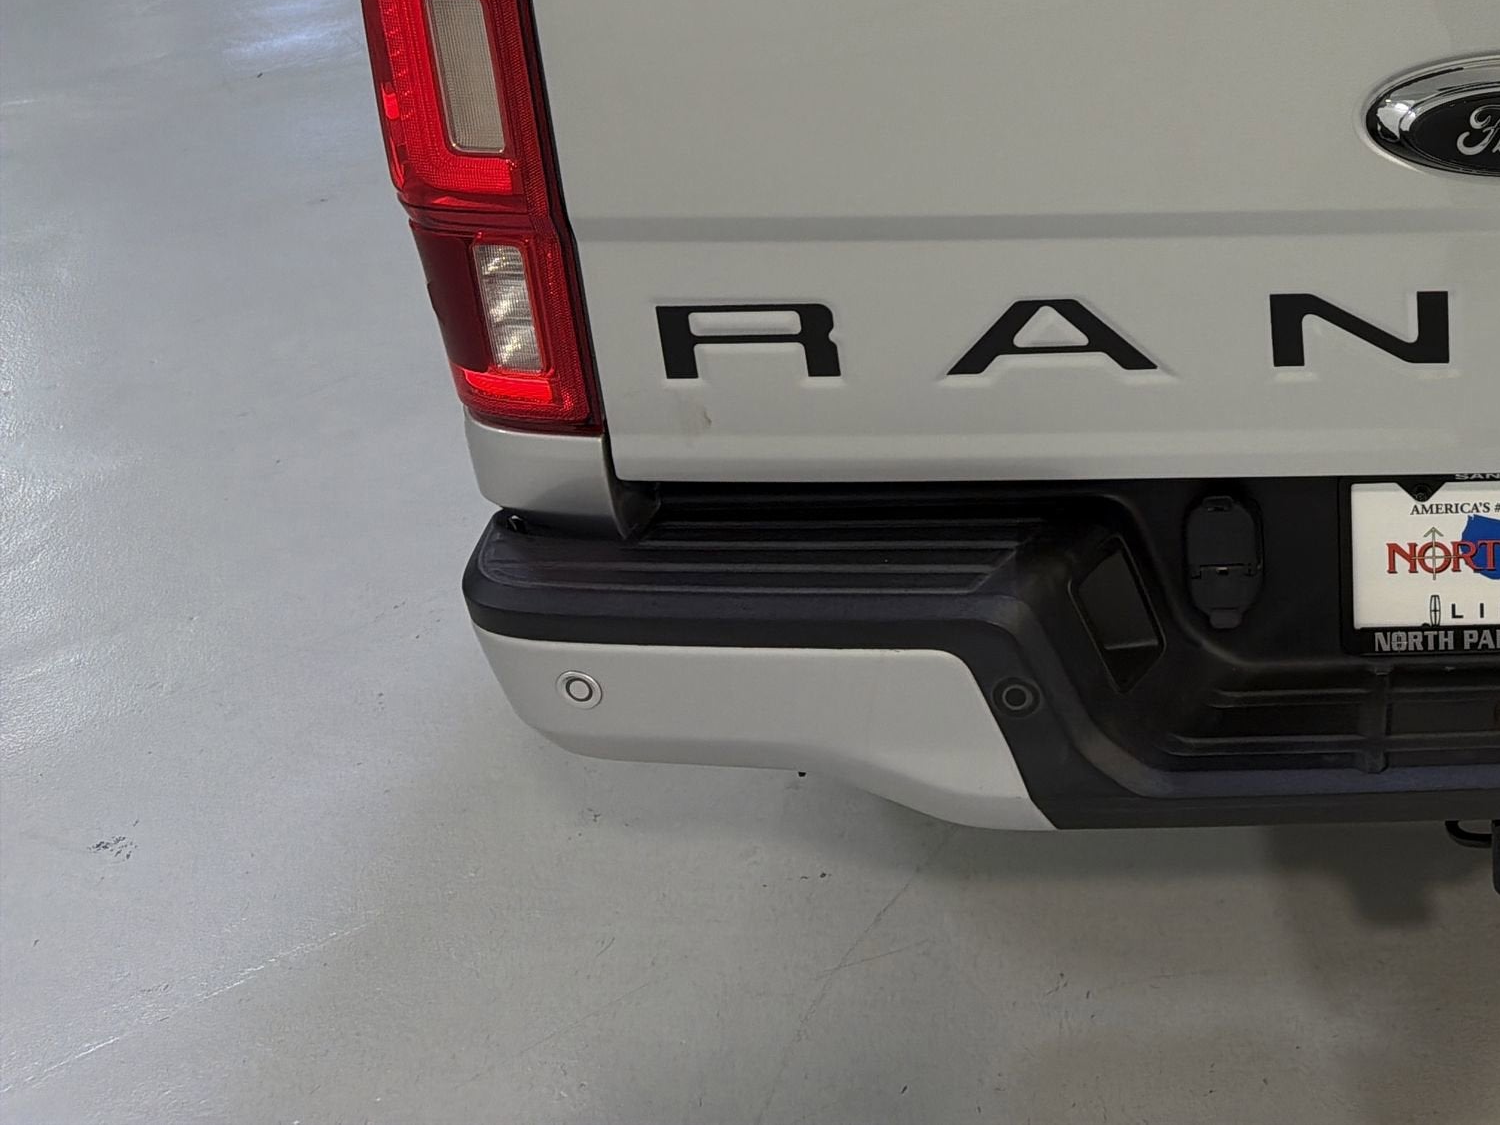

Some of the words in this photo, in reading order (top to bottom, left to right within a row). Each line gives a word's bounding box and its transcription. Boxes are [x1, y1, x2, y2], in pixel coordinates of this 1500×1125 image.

[1455, 472, 1500, 481] SAN
[1410, 501, 1491, 515] AMERICA'S
[1374, 630, 1455, 652] NORTH
